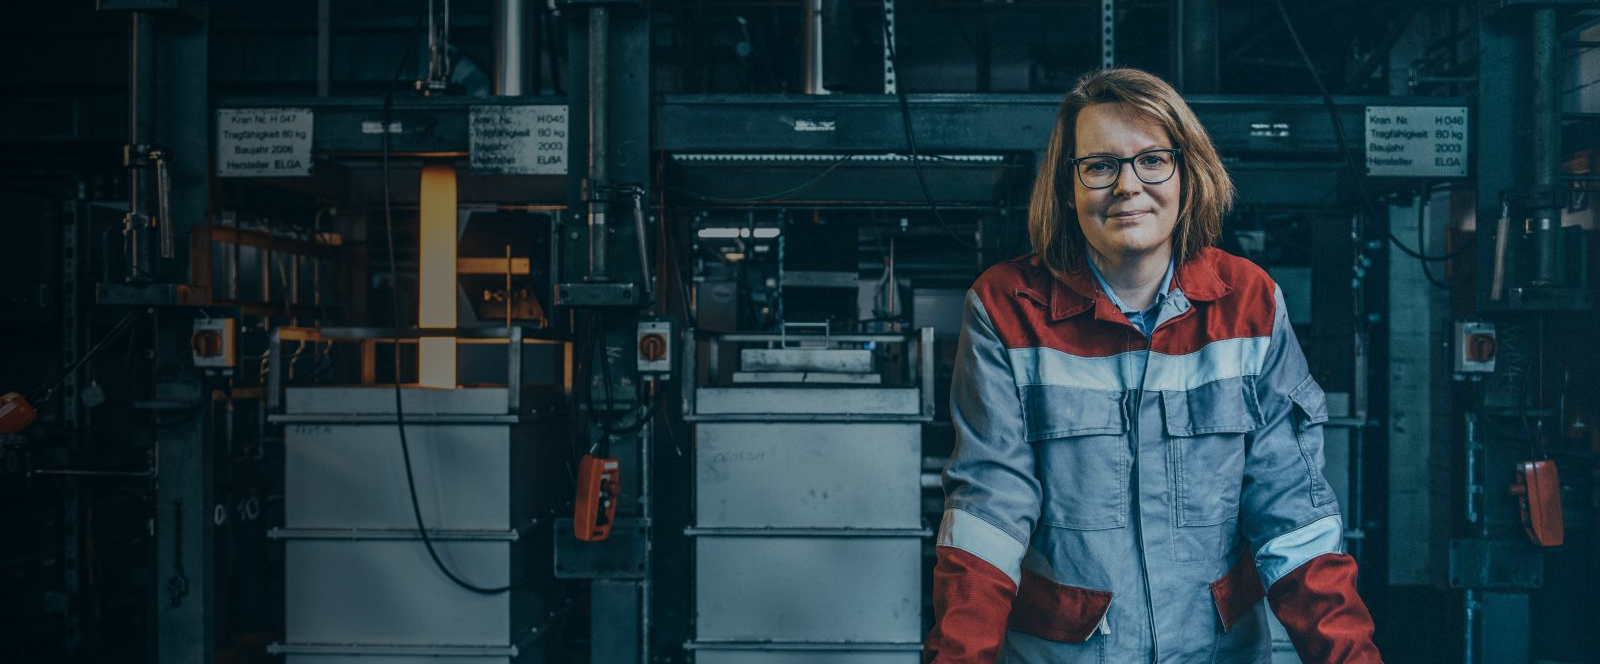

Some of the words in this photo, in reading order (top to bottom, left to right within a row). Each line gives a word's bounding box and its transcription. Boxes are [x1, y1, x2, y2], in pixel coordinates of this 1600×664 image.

[232, 116, 252, 124] Kran
[1369, 116, 1392, 124] Kran
[223, 130, 280, 141] Tragfähigkeit
[282, 130, 293, 139] 80
[295, 130, 306, 140] kg
[538, 128, 551, 137] 80
[553, 129, 566, 138] kg
[1370, 129, 1428, 140] Tragfähigkeit
[1435, 129, 1450, 139] 80
[1451, 130, 1463, 140] kg
[234, 145, 269, 156] Baujahr
[271, 145, 294, 154] 2006
[538, 142, 563, 151] 2003
[1369, 143, 1404, 154] Baujahr
[1434, 143, 1461, 153] 2003
[227, 161, 270, 170] Hersteller
[274, 159, 302, 170] ELGA
[1368, 157, 1412, 166] Hersteller
[1434, 157, 1461, 167] ELGA
